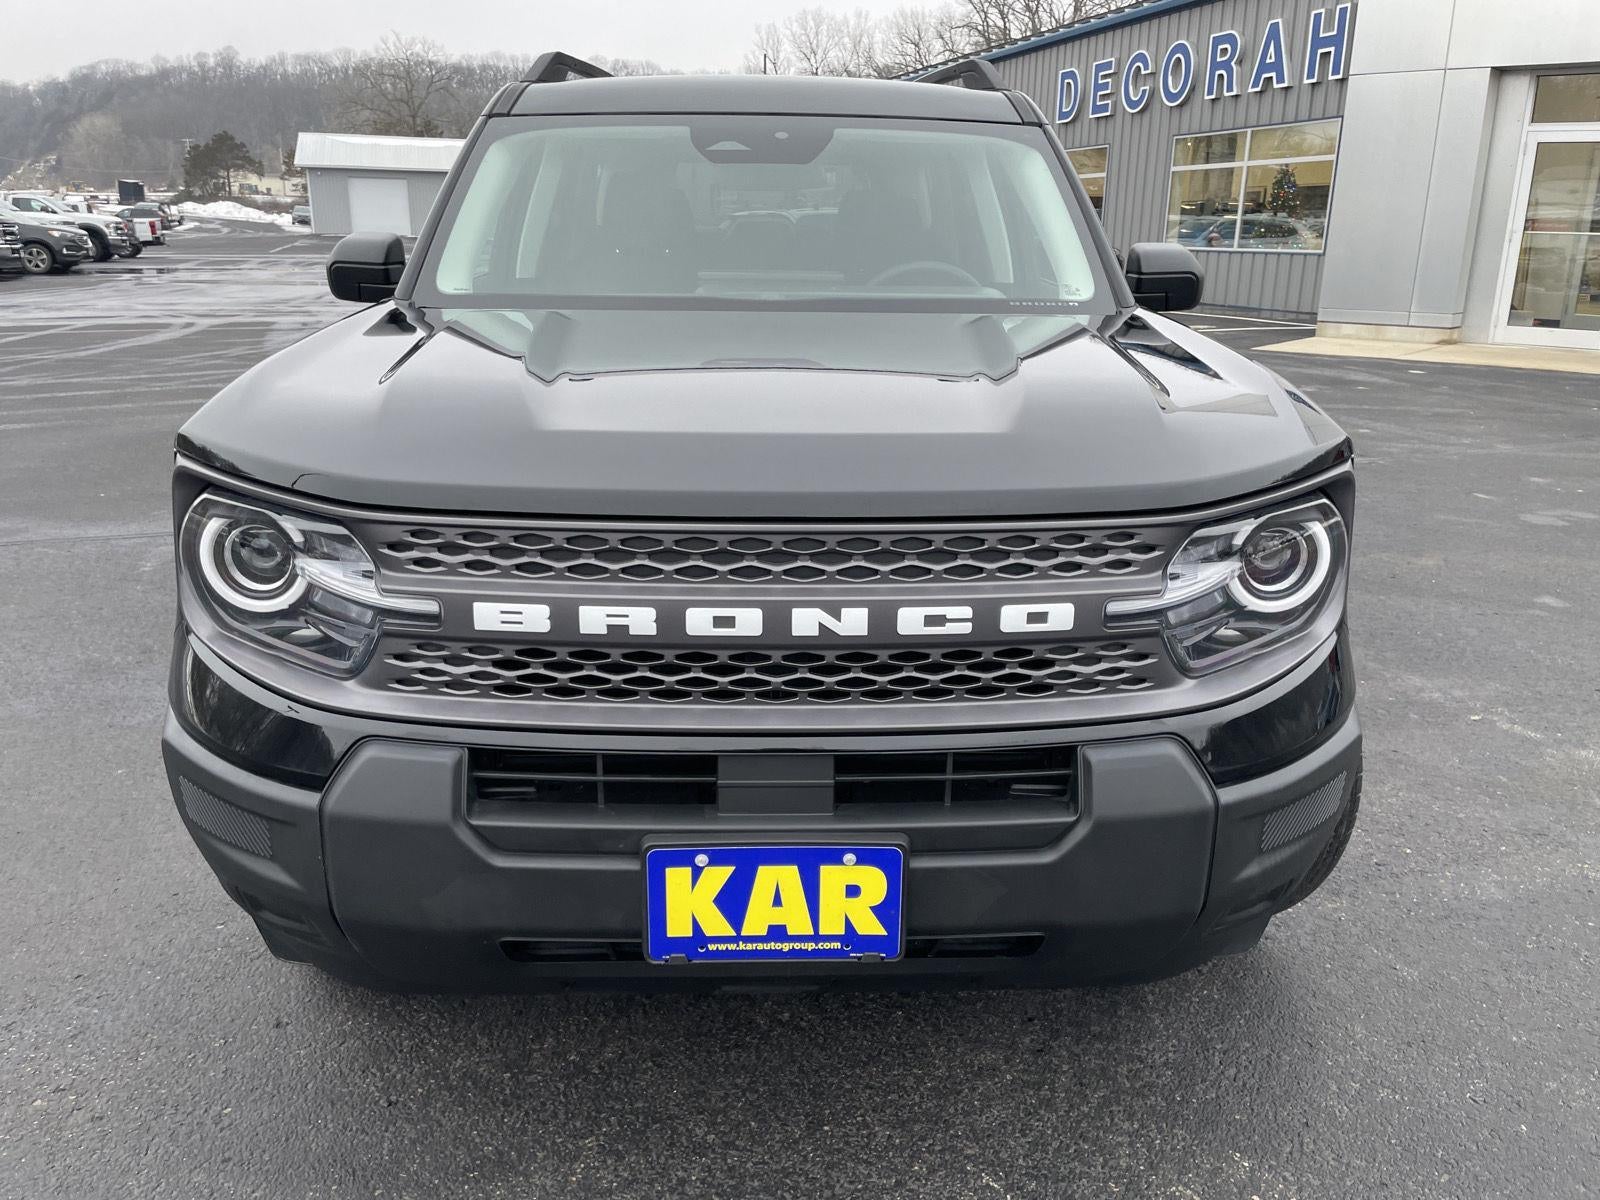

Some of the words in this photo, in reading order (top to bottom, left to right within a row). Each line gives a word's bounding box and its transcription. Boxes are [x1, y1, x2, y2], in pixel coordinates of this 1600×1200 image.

[1056, 3, 1352, 124] DECORAH
[472, 602, 1075, 637] BRONCO
[665, 865, 888, 938] KAR
[707, 941, 842, 952] www.karautogroup.com
